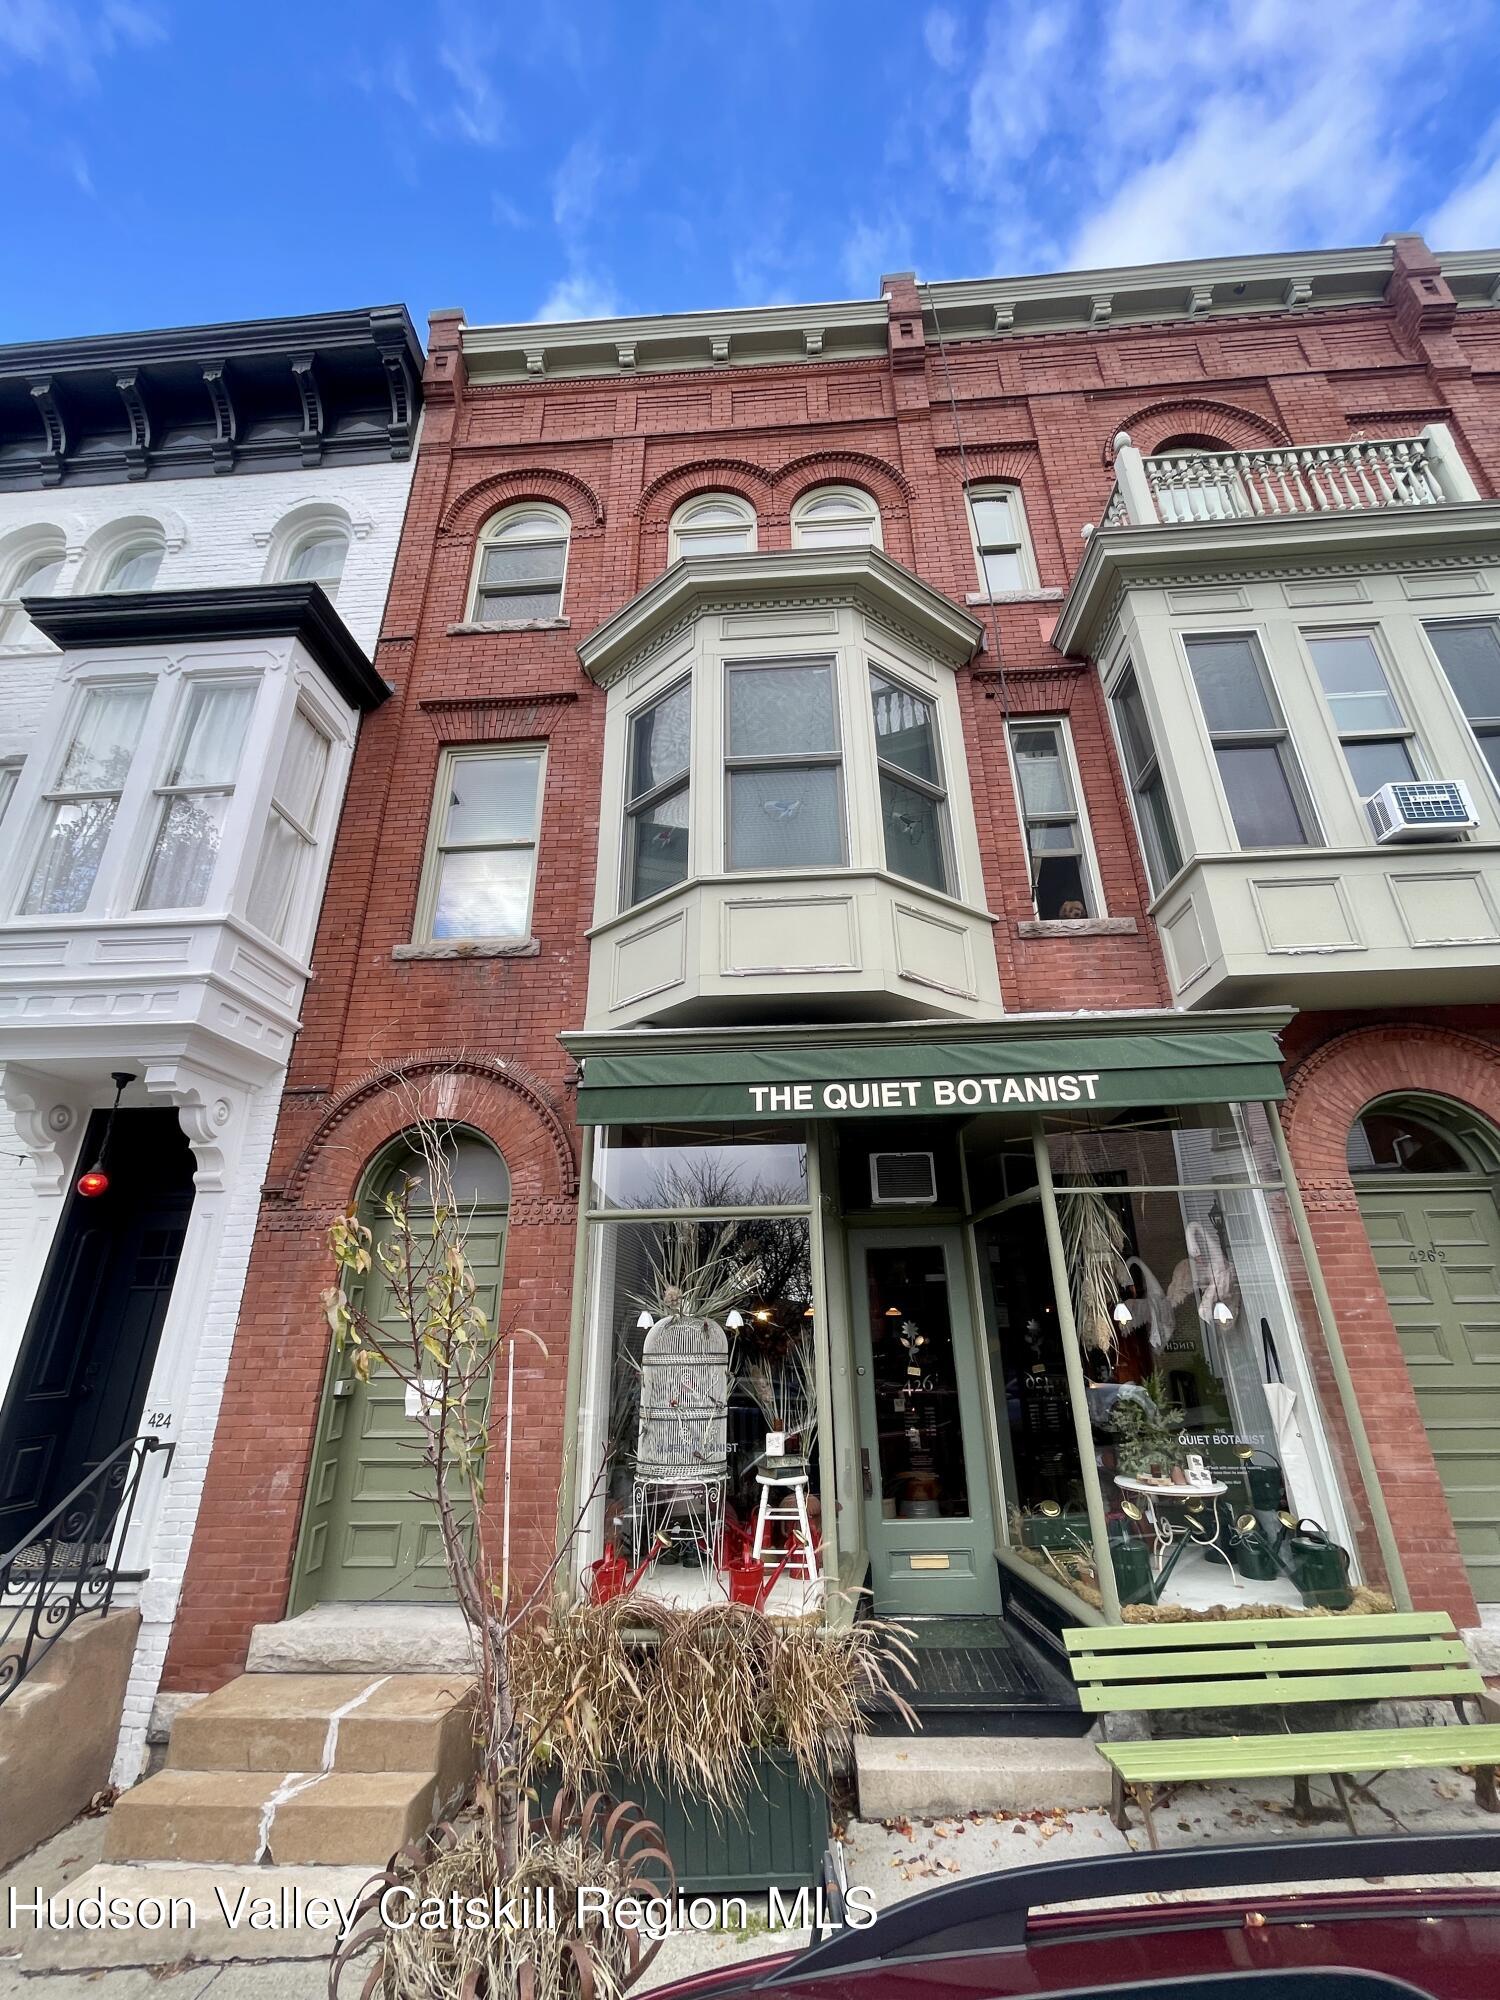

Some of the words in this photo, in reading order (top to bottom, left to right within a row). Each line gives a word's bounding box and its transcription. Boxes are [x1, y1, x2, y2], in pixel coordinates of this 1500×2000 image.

[749, 1086, 813, 1111] THE
[823, 1082, 921, 1110] QUIET
[934, 1075, 1099, 1105] BOTANIST
[148, 1412, 171, 1428] 424
[1179, 1435, 1210, 1445] QUIET
[1213, 1435, 1265, 1445] BOTANIST
